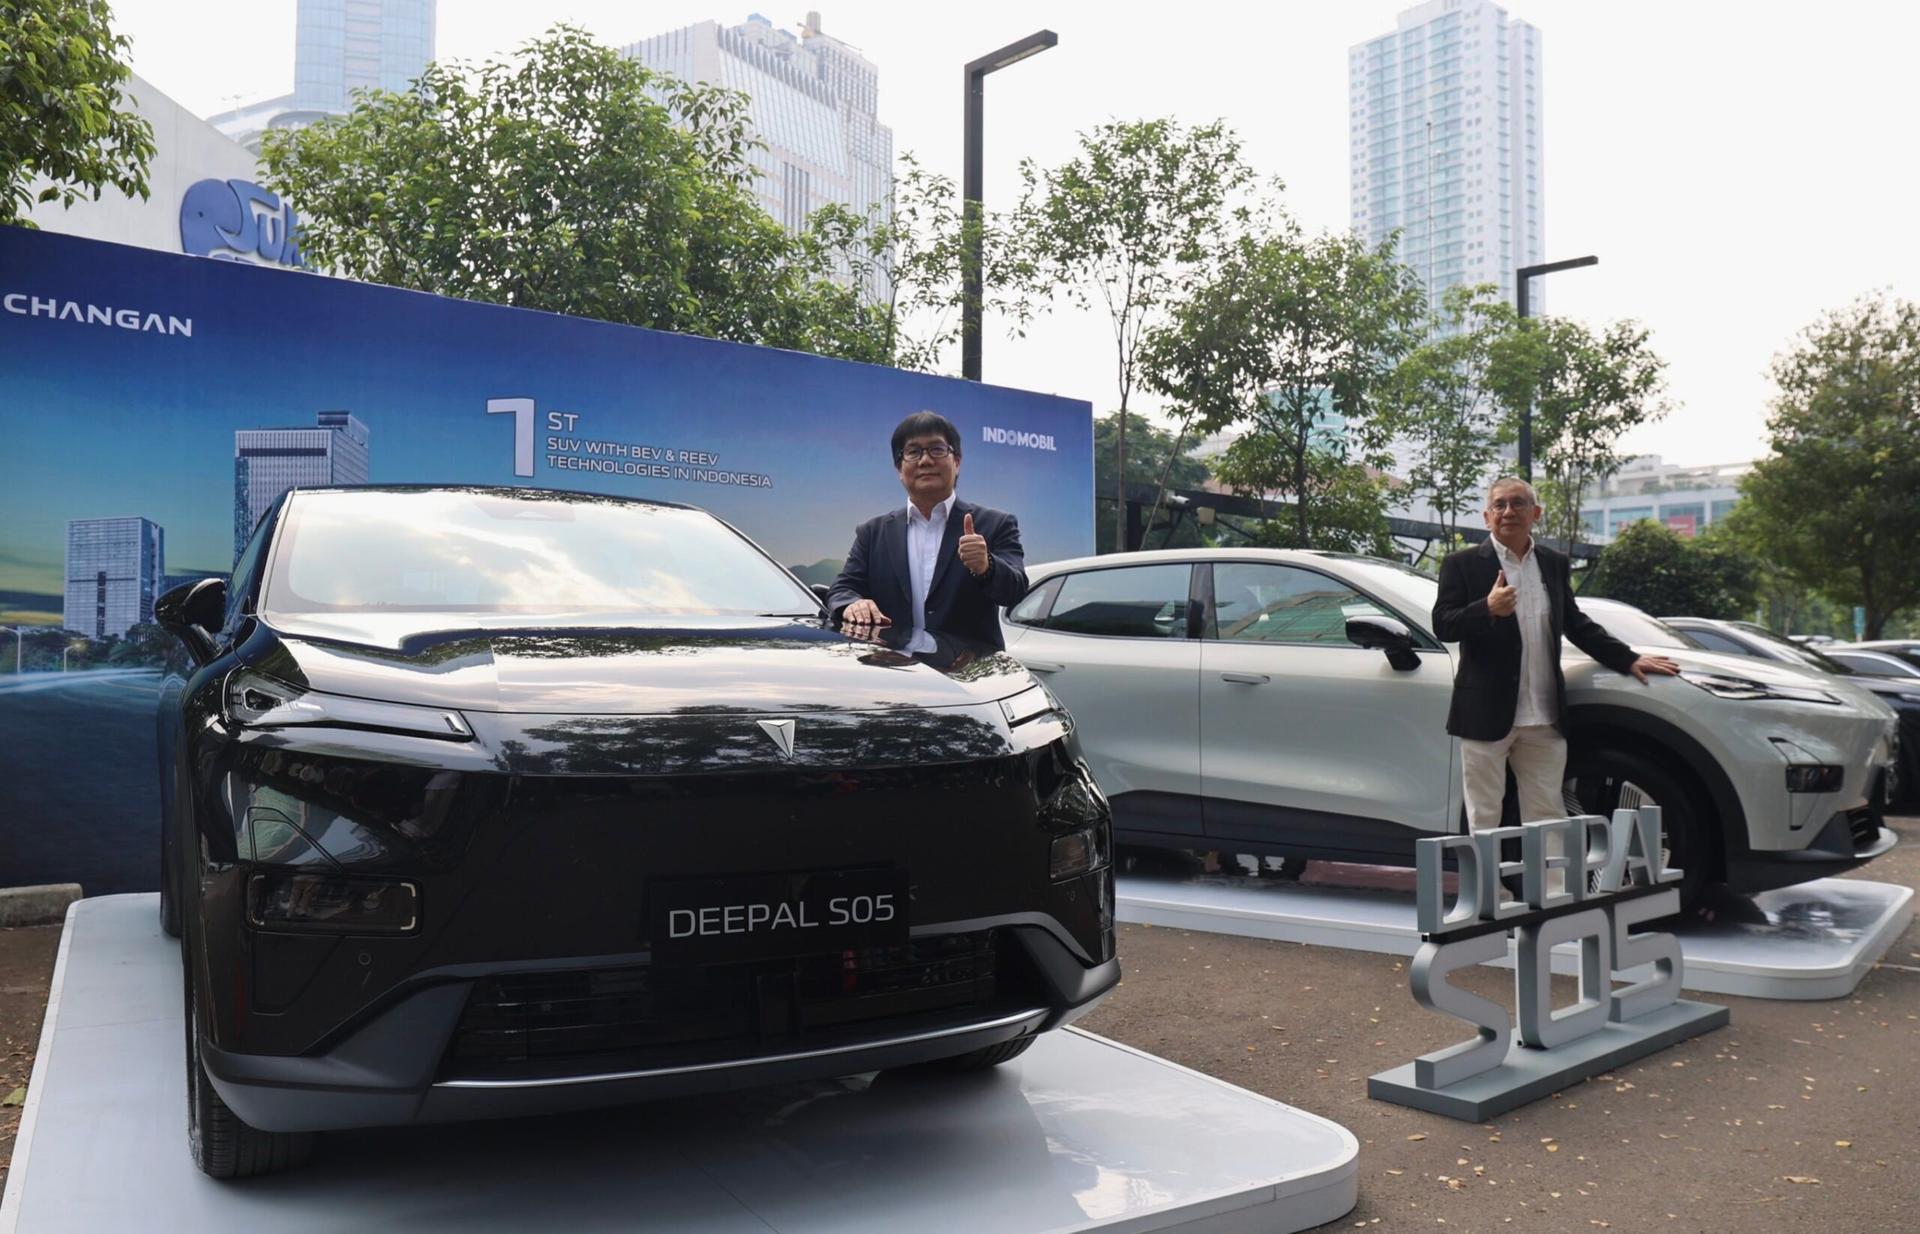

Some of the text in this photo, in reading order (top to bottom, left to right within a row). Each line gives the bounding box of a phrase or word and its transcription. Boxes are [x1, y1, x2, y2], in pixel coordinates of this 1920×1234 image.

[3, 293, 192, 337] CHANGAN
[487, 398, 579, 477] 1 ST
[547, 437, 718, 465] SUV WITH BEV & REEV
[983, 426, 1057, 451] INDOMOBIL
[547, 455, 772, 488] TECHNOLOGIES IN INDONESIA
[1416, 805, 1684, 934] DEEPAL
[669, 894, 894, 938] DEEPAL S05
[1410, 887, 1684, 1090] S05
